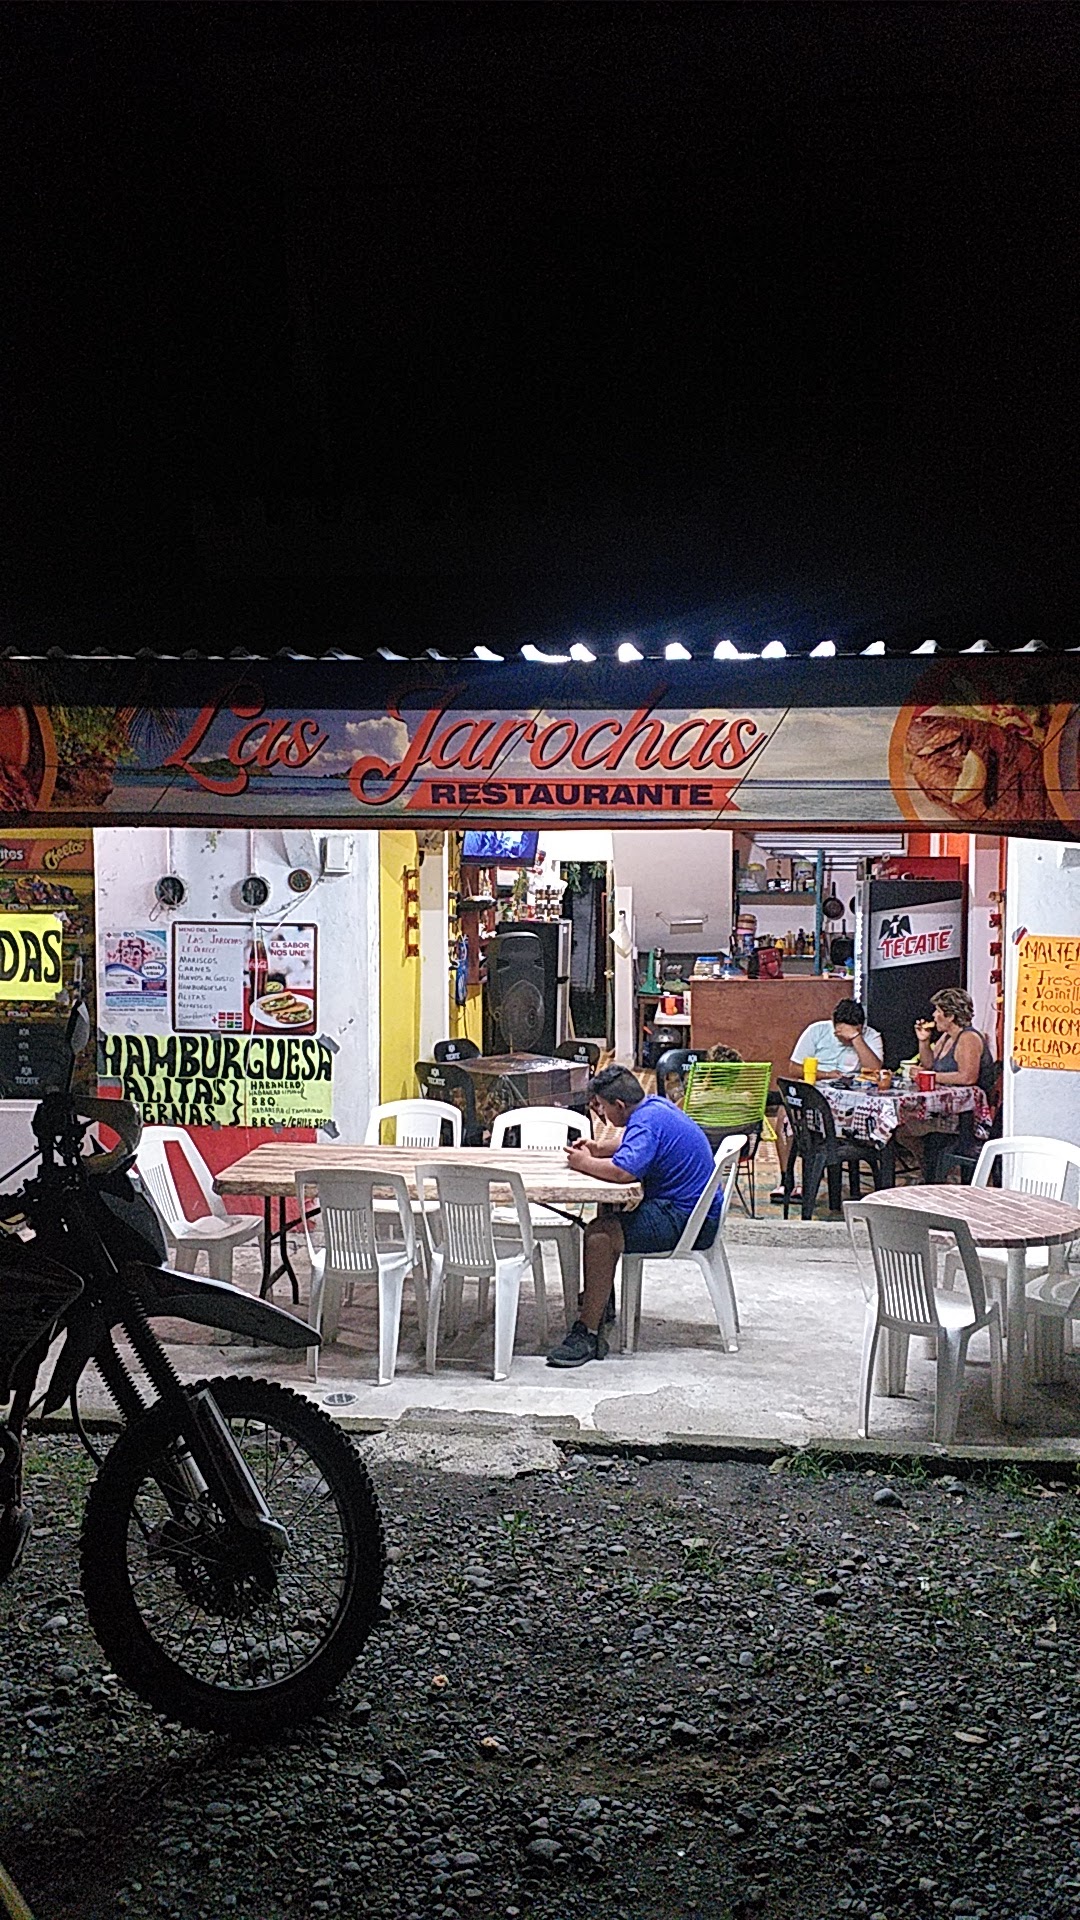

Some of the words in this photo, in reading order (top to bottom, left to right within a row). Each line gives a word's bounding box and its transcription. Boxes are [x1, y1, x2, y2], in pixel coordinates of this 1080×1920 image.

[163, 681, 329, 796] Las
[350, 681, 767, 805] Jarochas
[431, 784, 713, 804] RESTAURANTE
[44, 840, 85, 870] Cheetos
[0, 930, 61, 983] DAS
[878, 930, 954, 959] TECATE
[179, 956, 218, 964] MARISCOS
[98, 1035, 333, 1081] HAMBURGUESA
[123, 1077, 226, 1104] ALITAS
[250, 1081, 301, 1090] HABANERO
